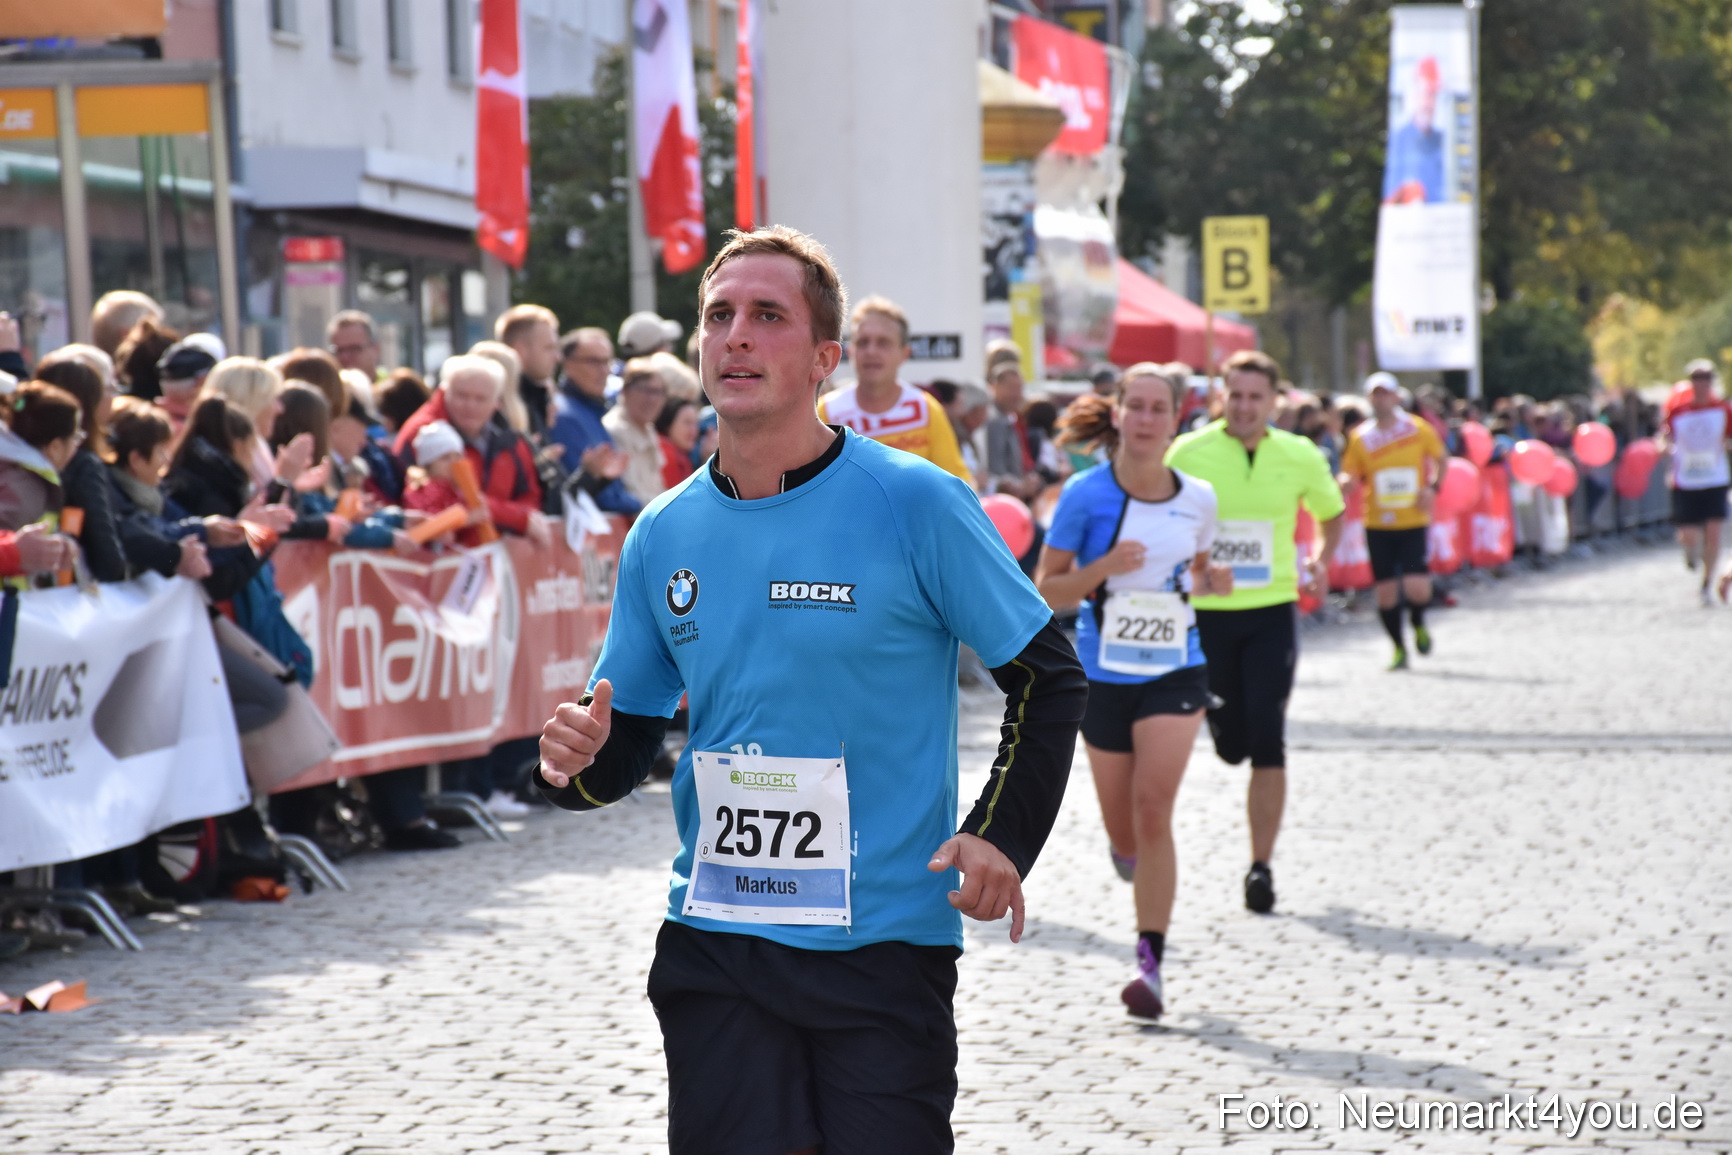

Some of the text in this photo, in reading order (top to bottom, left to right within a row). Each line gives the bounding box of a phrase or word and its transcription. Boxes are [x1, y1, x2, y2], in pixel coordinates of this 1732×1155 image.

[1222, 247, 1251, 291] B
[1211, 540, 1263, 561] 2998
[669, 571, 696, 588] BMW
[769, 581, 856, 605] BOCK
[768, 602, 793, 611] inspired
[794, 602, 802, 610] by
[824, 605, 857, 614] concepts
[670, 620, 699, 638] PARTL
[1117, 616, 1175, 643] 2226
[673, 633, 699, 647] Neumarkt
[743, 771, 797, 788] BOCK
[715, 805, 824, 859] 2572
[735, 875, 798, 896] Markus
